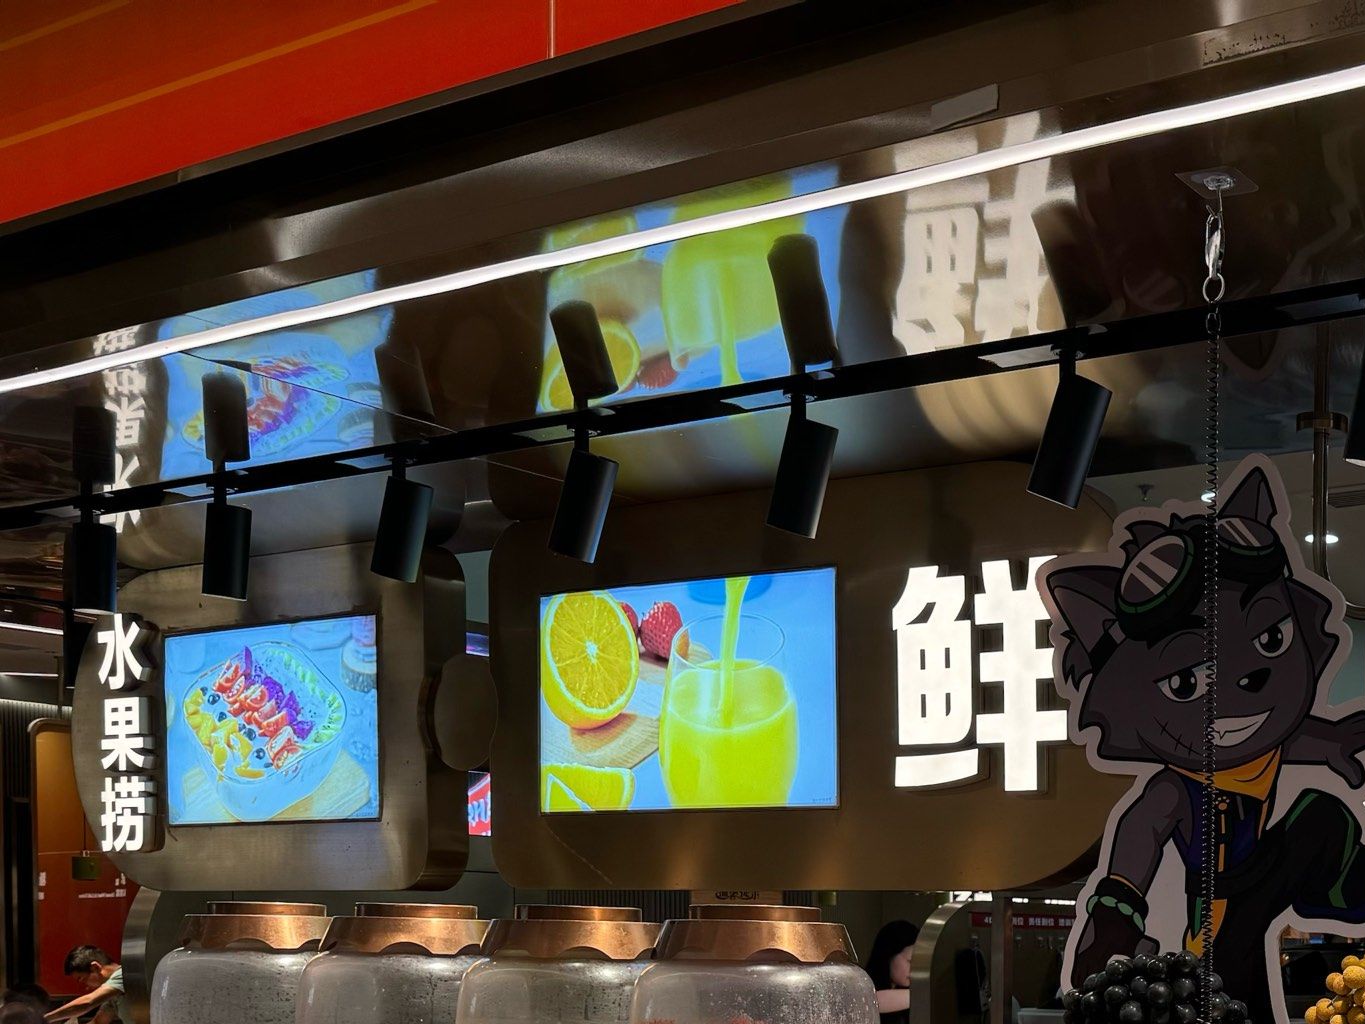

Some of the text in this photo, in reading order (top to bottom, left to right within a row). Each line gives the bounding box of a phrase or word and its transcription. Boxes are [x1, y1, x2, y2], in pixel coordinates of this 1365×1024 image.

[97, 612, 148, 853] 水果捞
[892, 555, 1068, 791] 鲜
